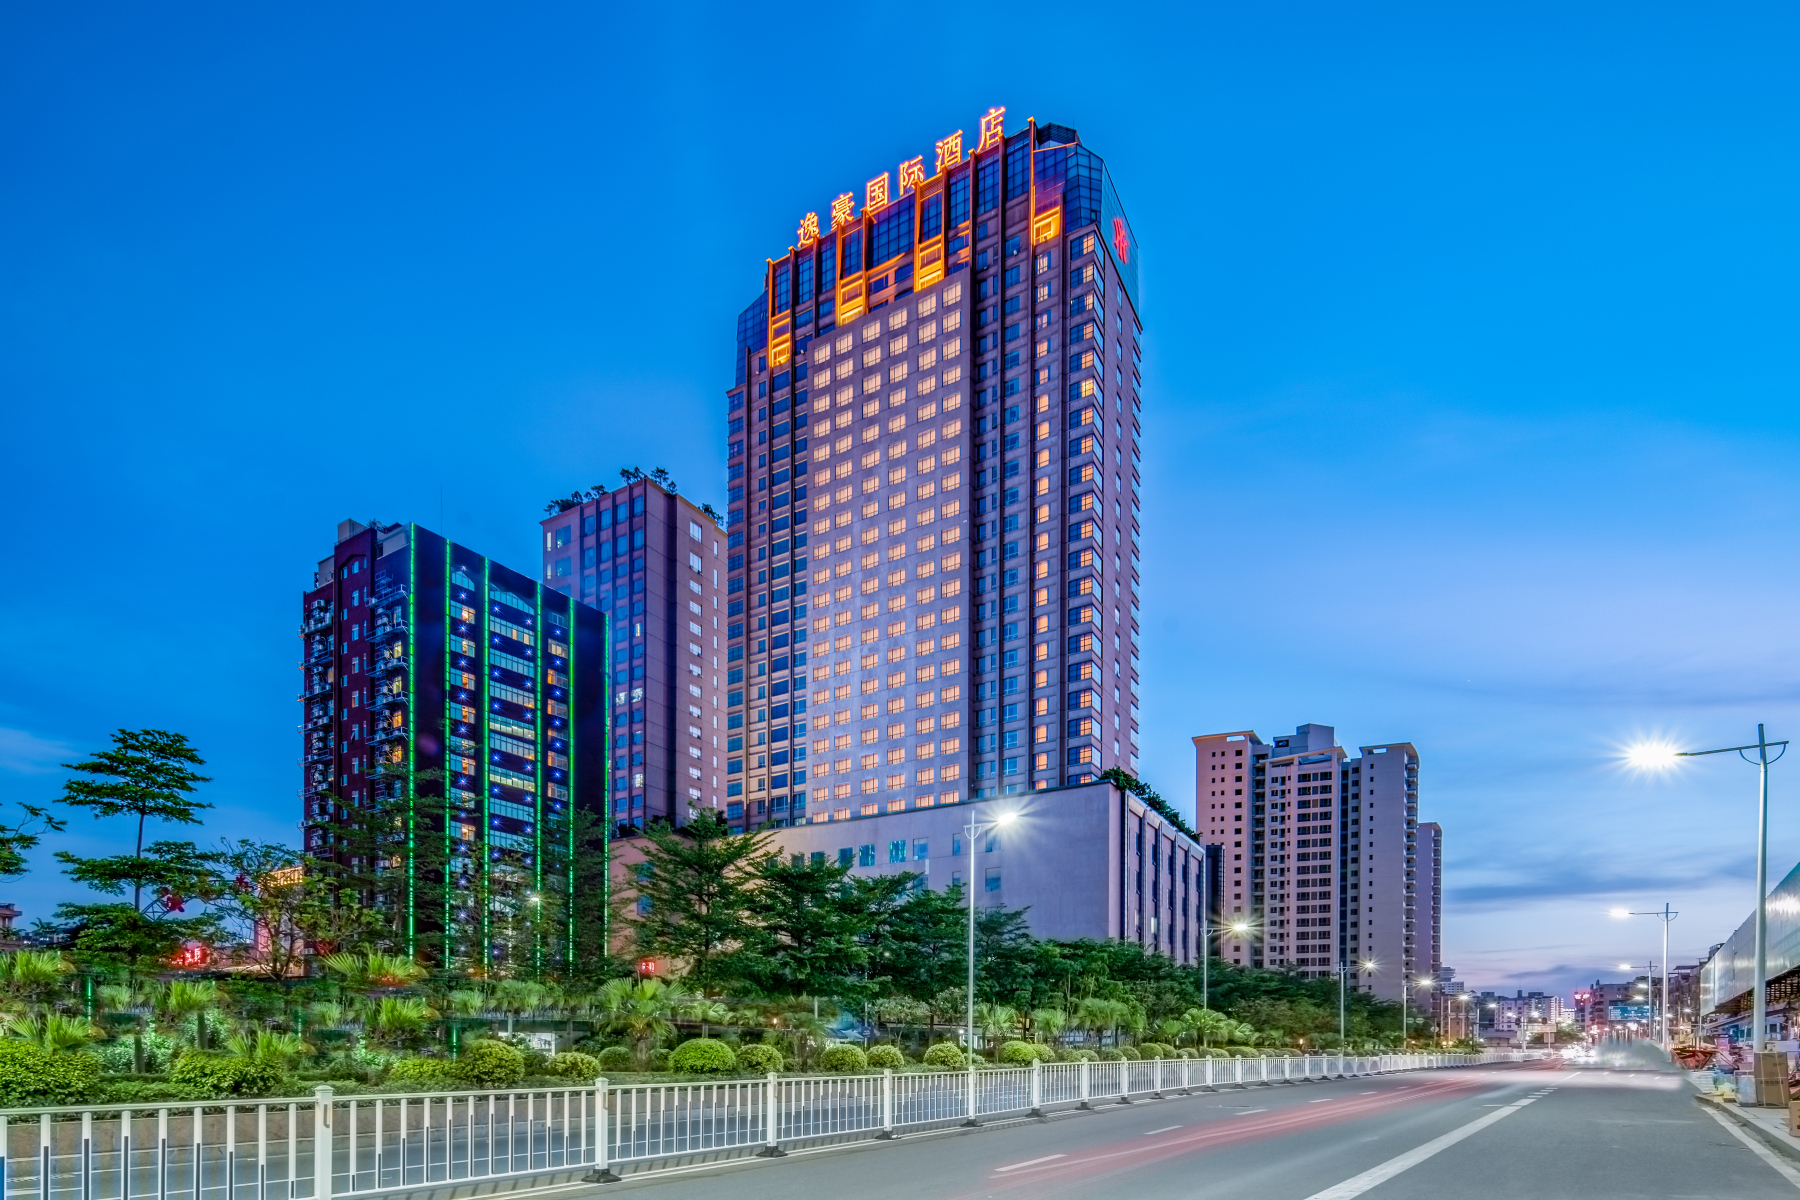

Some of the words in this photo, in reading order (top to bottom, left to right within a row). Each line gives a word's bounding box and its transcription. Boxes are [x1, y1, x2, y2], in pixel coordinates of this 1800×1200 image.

[797, 106, 1006, 247] 逸豪国际酒店
